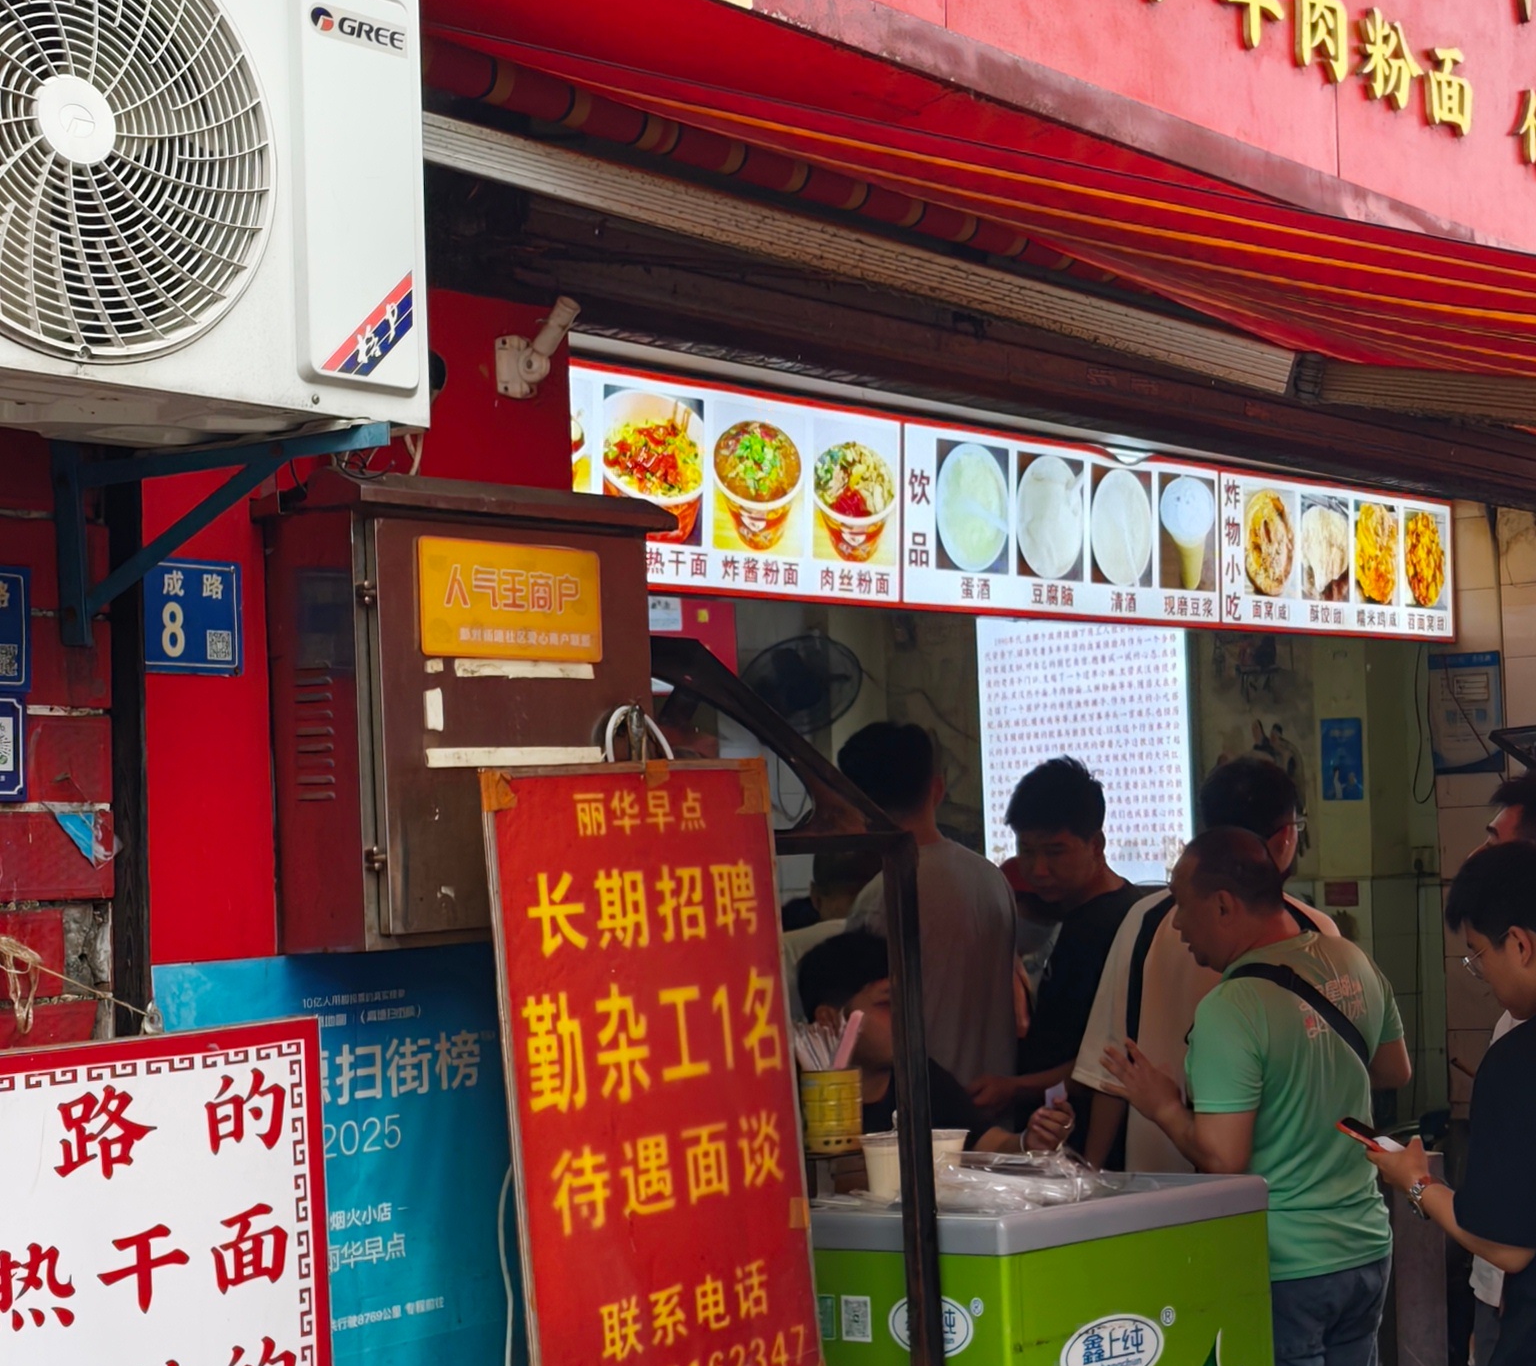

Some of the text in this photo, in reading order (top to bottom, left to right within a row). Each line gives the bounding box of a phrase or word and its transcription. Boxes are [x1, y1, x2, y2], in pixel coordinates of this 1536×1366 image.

[338, 17, 405, 50] GREE
[907, 468, 931, 569] 饮品
[646, 548, 890, 596] 热干面 炸酱粉面 肉丝粉面
[1224, 478, 1241, 621] 炸物小吃
[163, 570, 223, 599] 成路
[444, 564, 580, 614] 人气王商户
[961, 576, 1213, 618] 蛋酒 豆腐脑 清酒 现磨豆浆
[162, 602, 185, 657] 8
[574, 787, 706, 836] 丽华早点
[527, 859, 759, 959] 长期招聘
[522, 966, 784, 1115] 勤杂工1名
[54, 1067, 287, 1180] 路的
[325, 1114, 402, 1159] 2025
[552, 1110, 785, 1236] 待遇面谈
[330, 1202, 393, 1232] 烟火小店
[0, 1203, 288, 1333] 热干面
[600, 1257, 770, 1363] 联系电话
